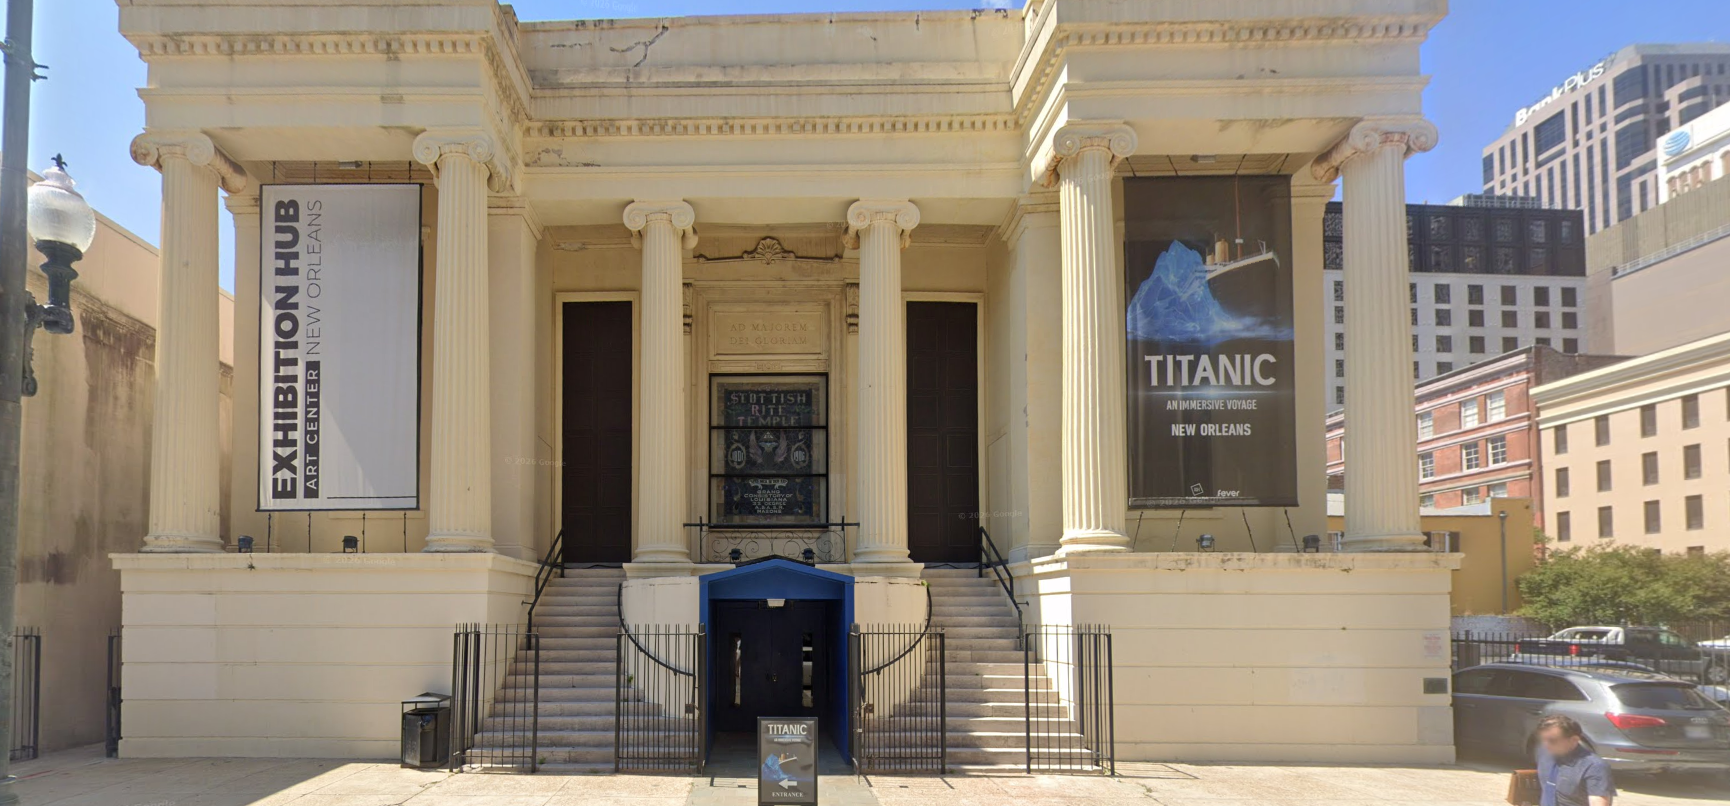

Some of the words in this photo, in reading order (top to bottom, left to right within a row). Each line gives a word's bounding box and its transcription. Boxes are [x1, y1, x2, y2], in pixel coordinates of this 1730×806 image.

[1515, 61, 1605, 127] BankPlus
[275, 199, 300, 276] HUB
[307, 200, 322, 298] ORLEANS
[306, 305, 321, 355] NEW
[730, 323, 746, 332] AD
[752, 323, 807, 332] MAJOREM
[730, 336, 749, 345] DEI
[754, 336, 807, 345] GLORIAM
[1144, 353, 1277, 386] TITANIC
[272, 286, 299, 499] EXHIBITION
[307, 369, 318, 444] CENTER
[751, 404, 786, 416] RITE
[1166, 400, 1178, 410] AN
[1179, 399, 1225, 410] IMMERSIVE
[1226, 399, 1257, 410] VOYAGE
[737, 416, 800, 426] TEMPLE
[1171, 423, 1196, 436] NEW
[1200, 423, 1252, 436] ORLEANS
[306, 454, 317, 489] ART
[1217, 489, 1240, 497] fever
[767, 724, 807, 735] TITANIC
